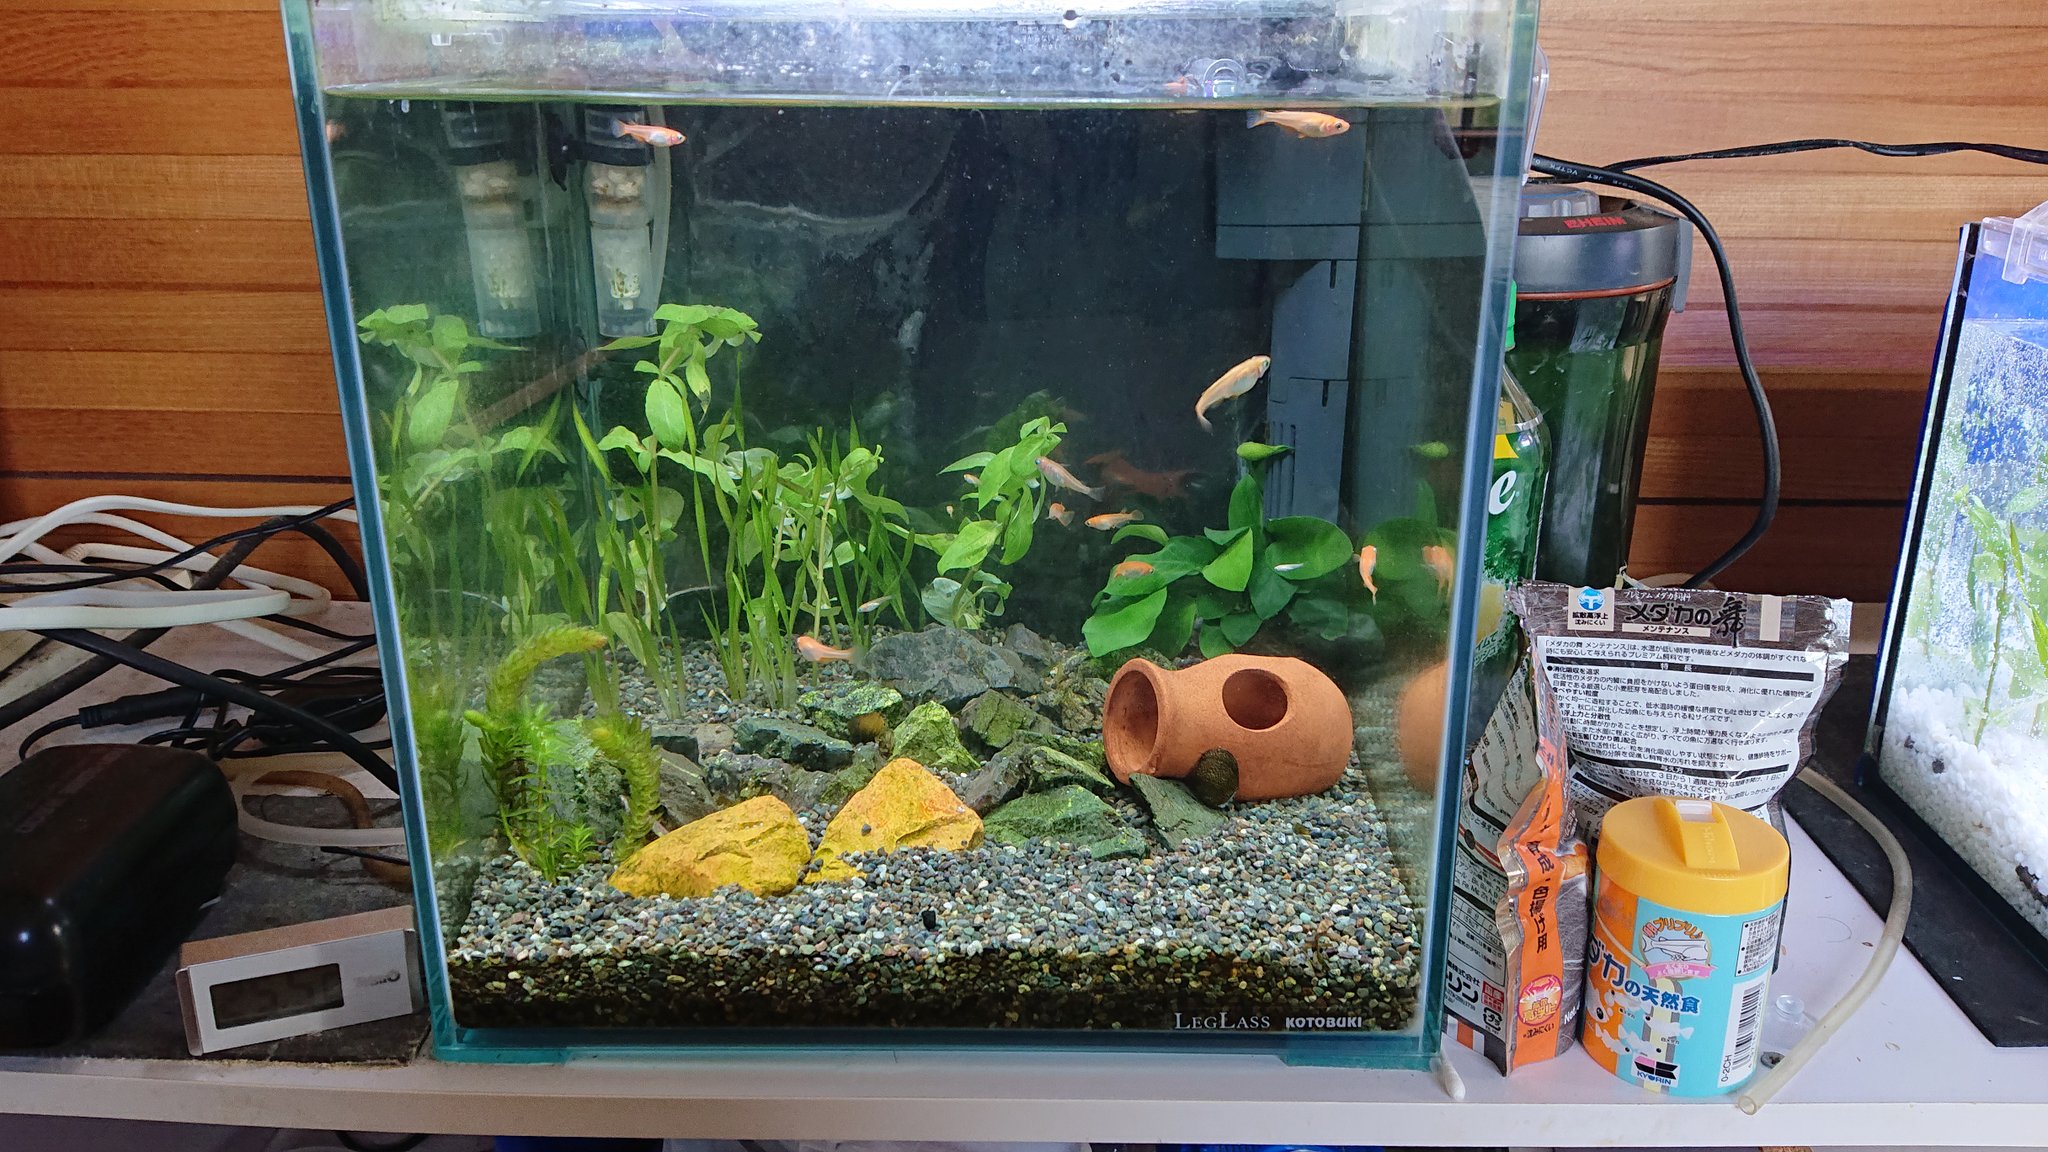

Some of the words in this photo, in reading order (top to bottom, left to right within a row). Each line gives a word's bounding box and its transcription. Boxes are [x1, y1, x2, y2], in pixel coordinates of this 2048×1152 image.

[1564, 217, 1627, 229] EHEIM
[1643, 626, 1690, 635] メンテナンス
[1285, 1016, 1362, 1029] KOTOBUKI
[1637, 1071, 1672, 1085] KYORIN
